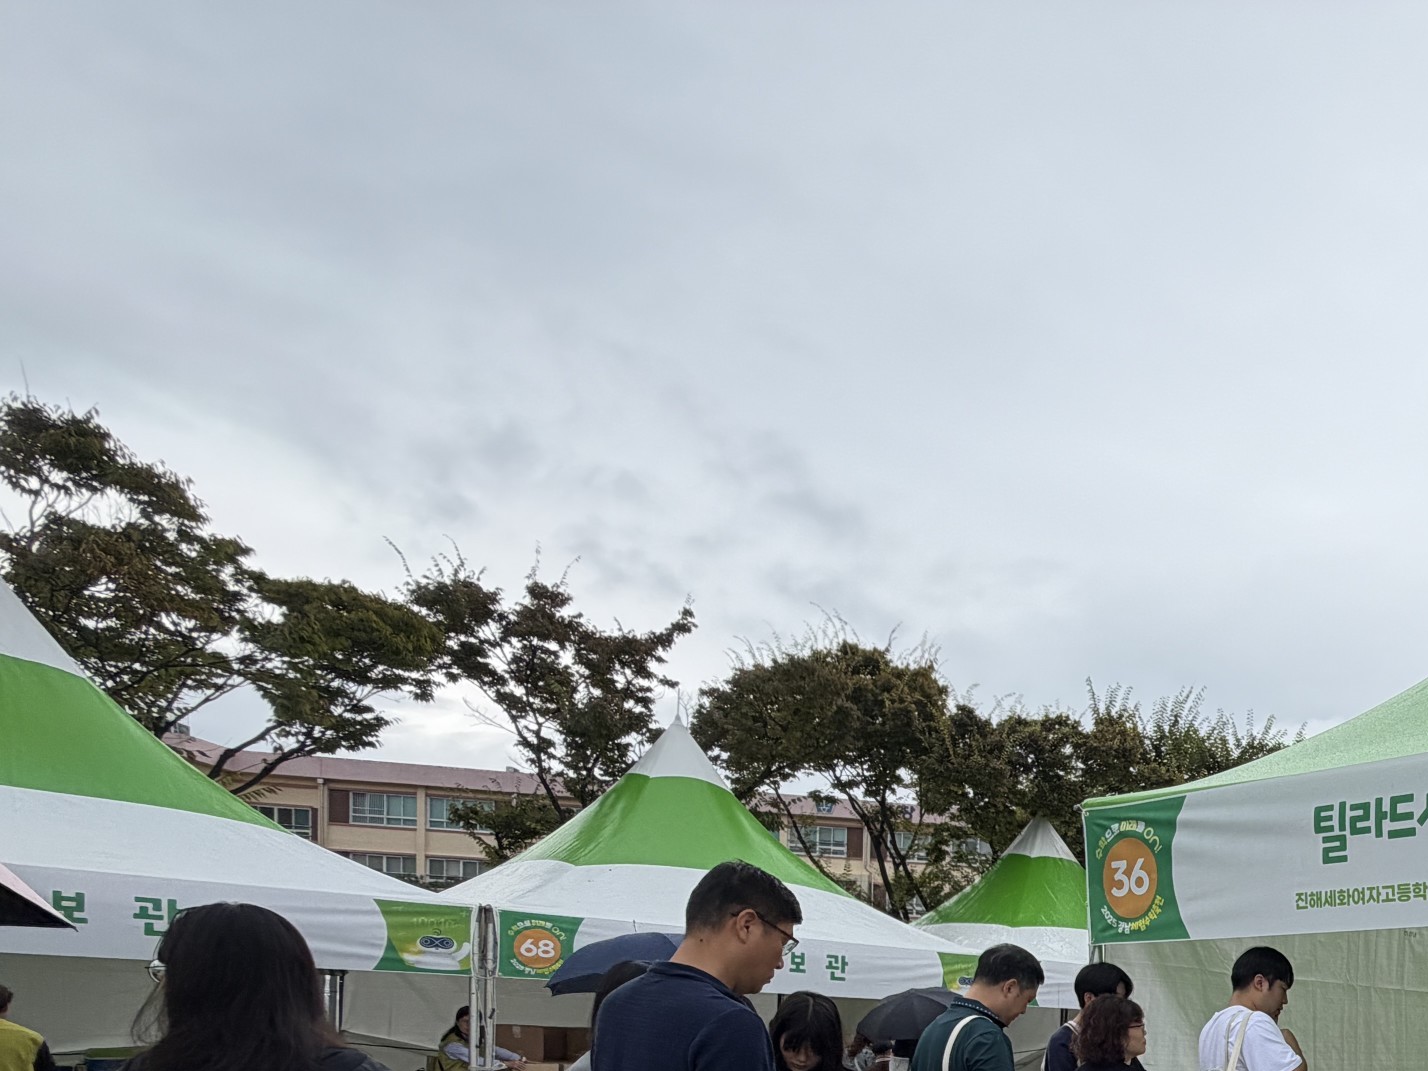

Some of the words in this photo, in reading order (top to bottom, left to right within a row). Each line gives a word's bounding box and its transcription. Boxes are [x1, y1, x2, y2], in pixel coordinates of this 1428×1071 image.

[1110, 857, 1150, 898] 36
[1100, 905, 1118, 928] 2025
[519, 938, 556, 958] 68
